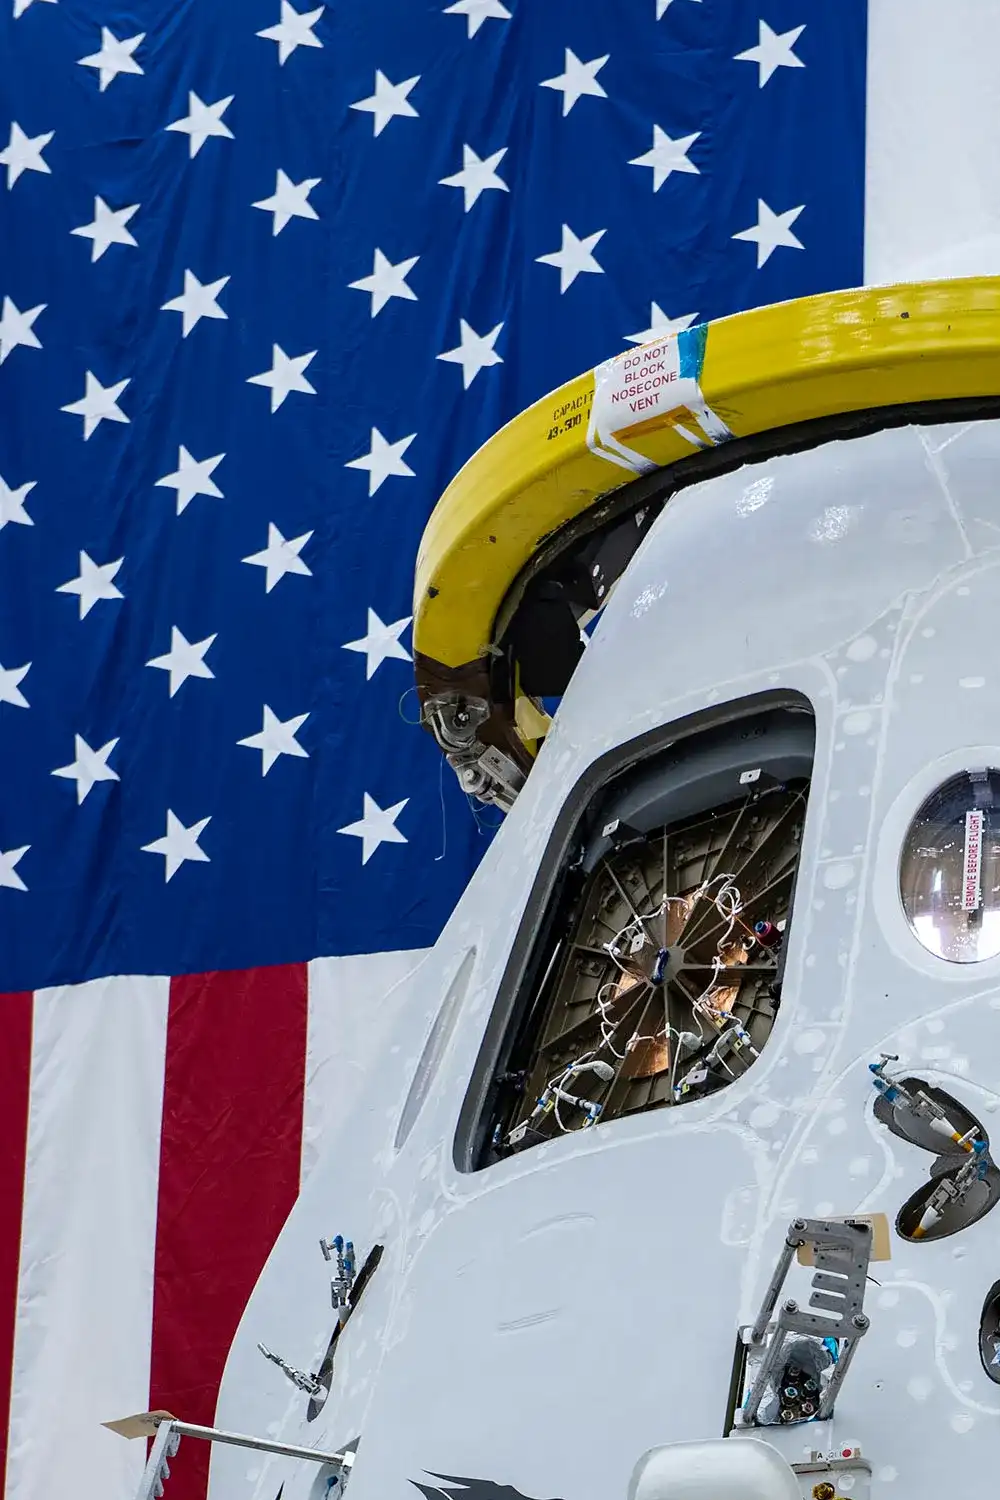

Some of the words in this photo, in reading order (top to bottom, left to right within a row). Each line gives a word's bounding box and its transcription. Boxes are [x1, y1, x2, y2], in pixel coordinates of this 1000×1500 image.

[623, 356, 641, 370] DO
[643, 345, 668, 363] NOT
[611, 371, 678, 403] NOSECONE
[624, 361, 666, 384] BLOCK
[553, 390, 595, 421] CAPACIT
[629, 393, 661, 413] VENT
[968, 814, 980, 842] FLIGHT
[967, 843, 978, 873] BEFORE
[965, 875, 977, 907] REMOVE
